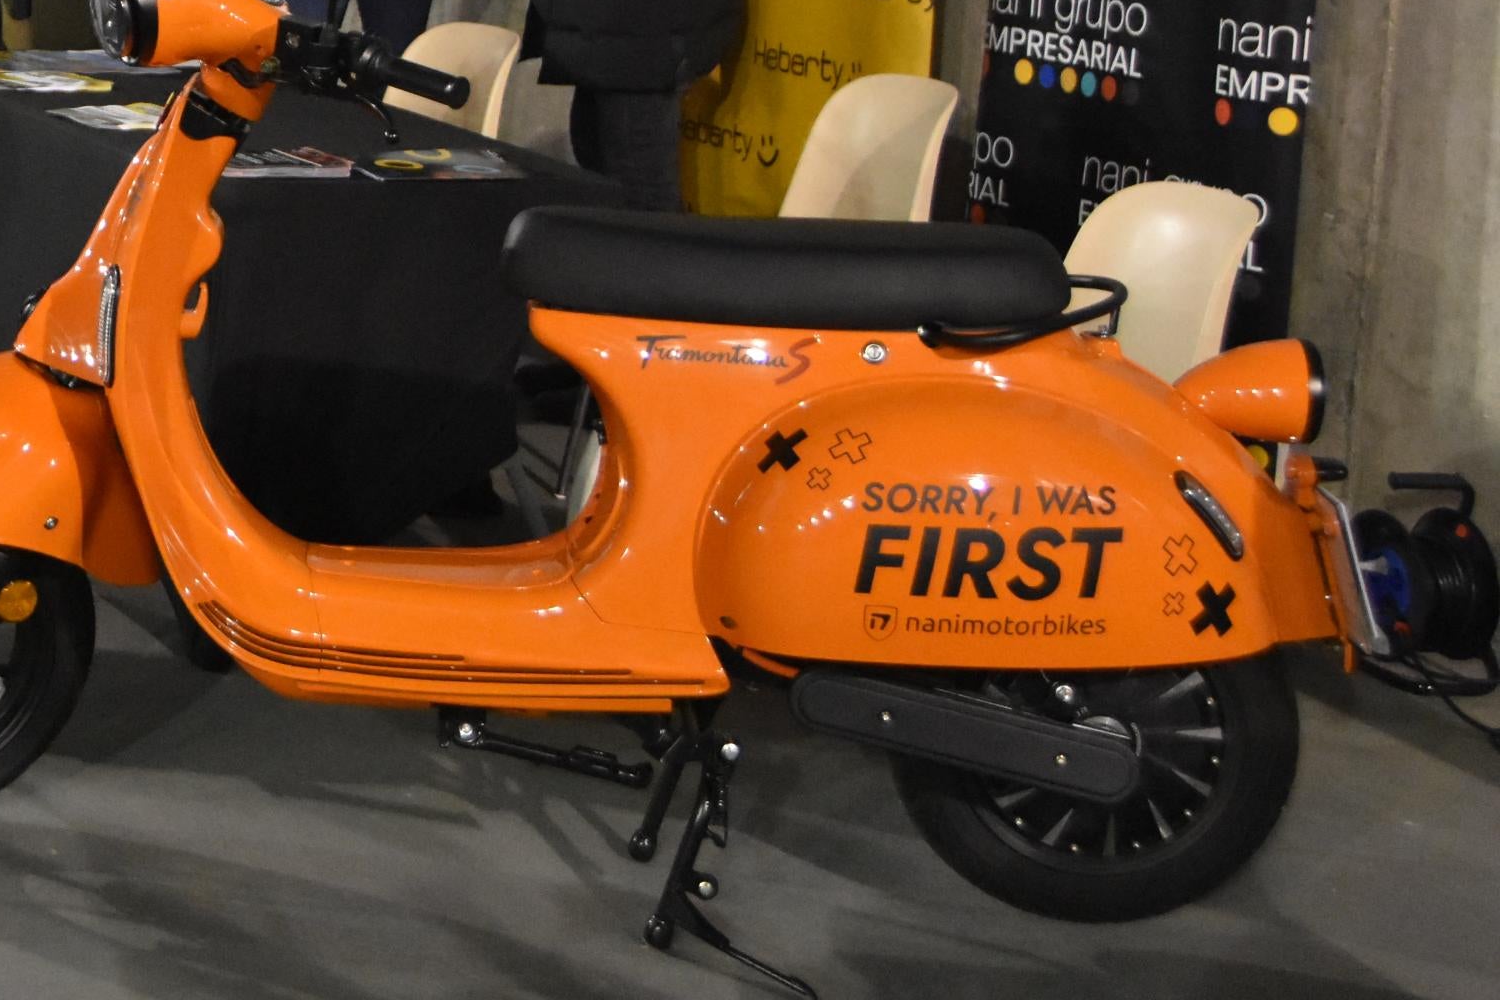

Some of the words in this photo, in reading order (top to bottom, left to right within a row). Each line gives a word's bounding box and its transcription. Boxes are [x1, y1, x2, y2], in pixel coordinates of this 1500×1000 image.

[1218, 16, 1312, 62] nani
[753, 37, 843, 90] Heberty
[1215, 64, 1311, 104] EMPR
[861, 482, 997, 522] SORRY,
[1012, 486, 1022, 516] I
[1037, 485, 1117, 516] WAS
[854, 524, 1124, 602] FIRST
[905, 613, 1107, 637] nanimotorbikes
